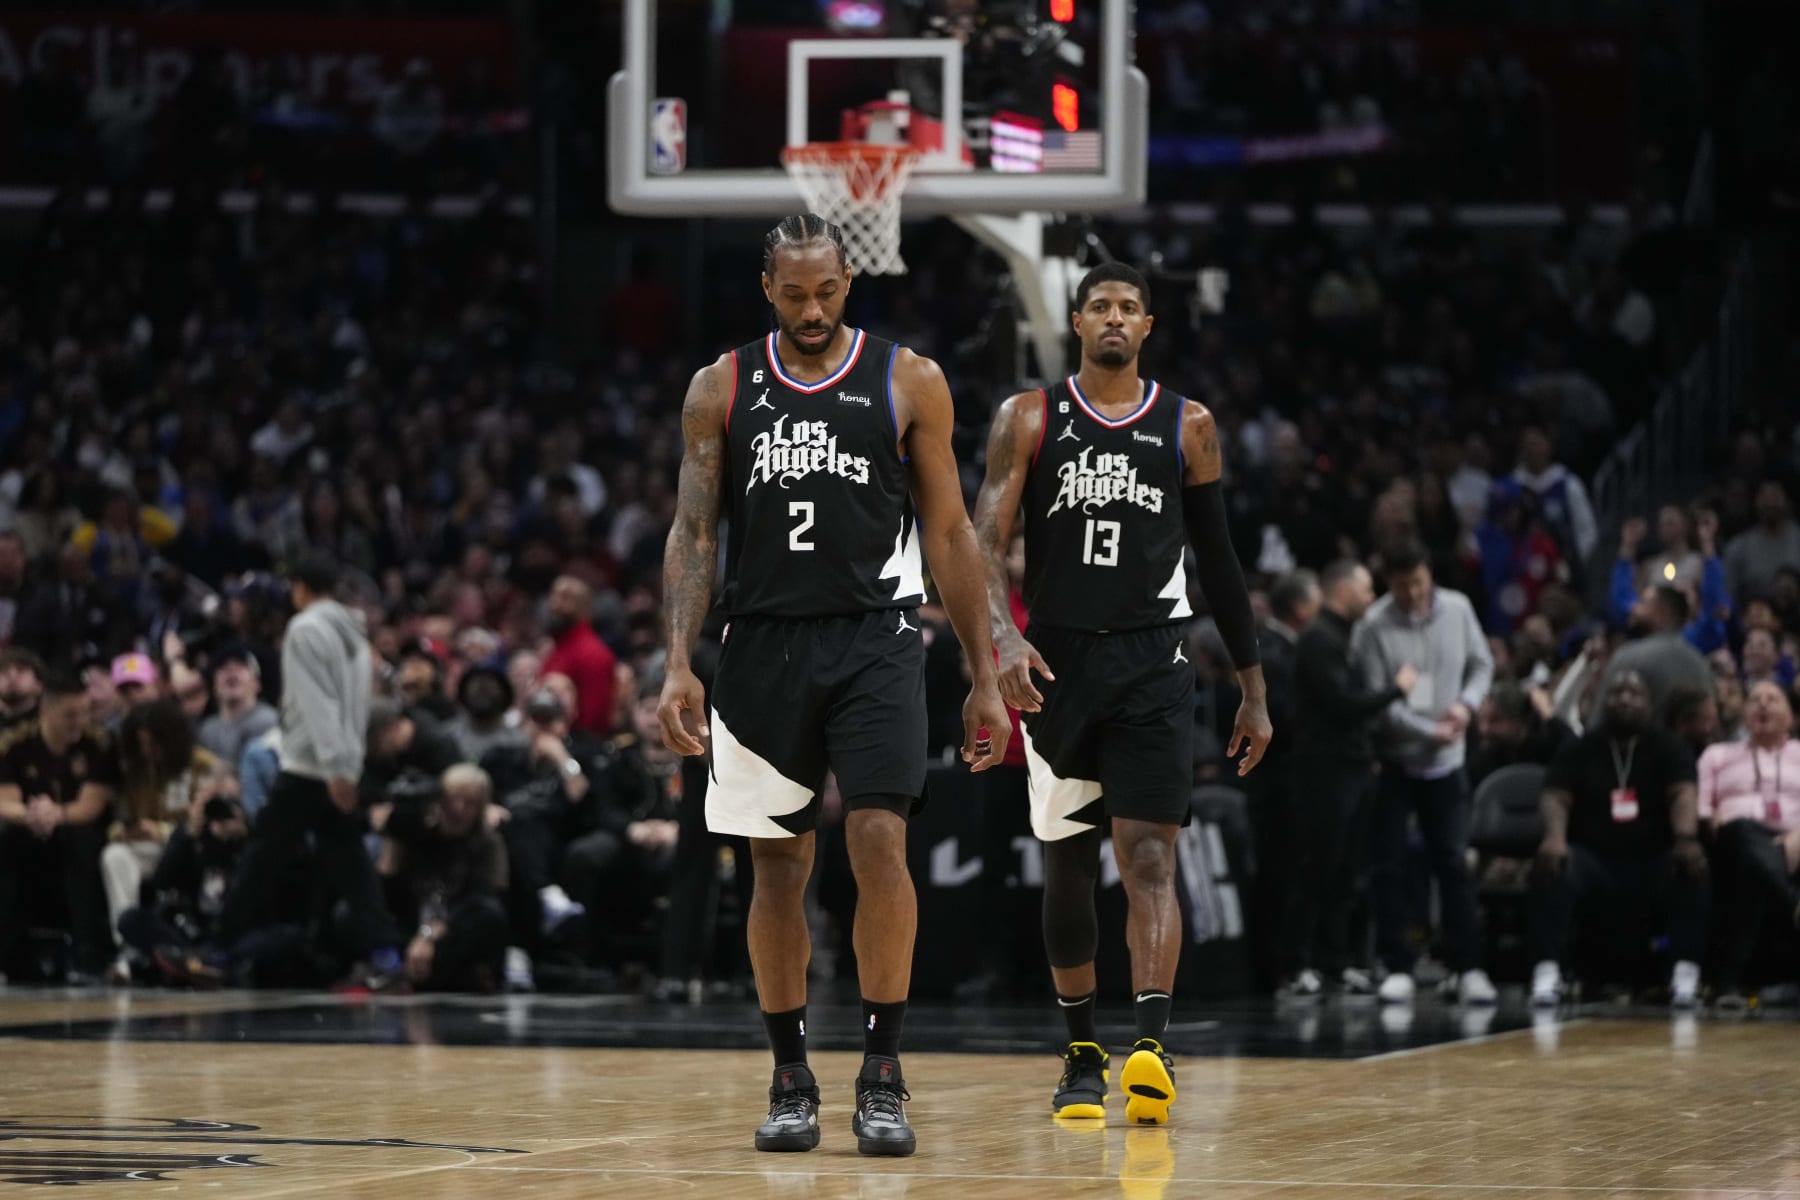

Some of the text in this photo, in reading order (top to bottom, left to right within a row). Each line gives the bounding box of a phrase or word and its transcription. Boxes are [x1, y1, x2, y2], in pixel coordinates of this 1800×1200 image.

[29, 22, 386, 108] Cliprs
[752, 369, 764, 384] 6
[838, 391, 872, 407] honey
[1058, 401, 1070, 414] 6
[769, 413, 829, 448] Los
[1131, 430, 1164, 447] honey
[745, 431, 871, 497] Angeles
[1075, 445, 1130, 478] Los
[1046, 461, 1165, 519] Angeles
[788, 501, 815, 551] 2
[1082, 518, 1121, 567] 13
